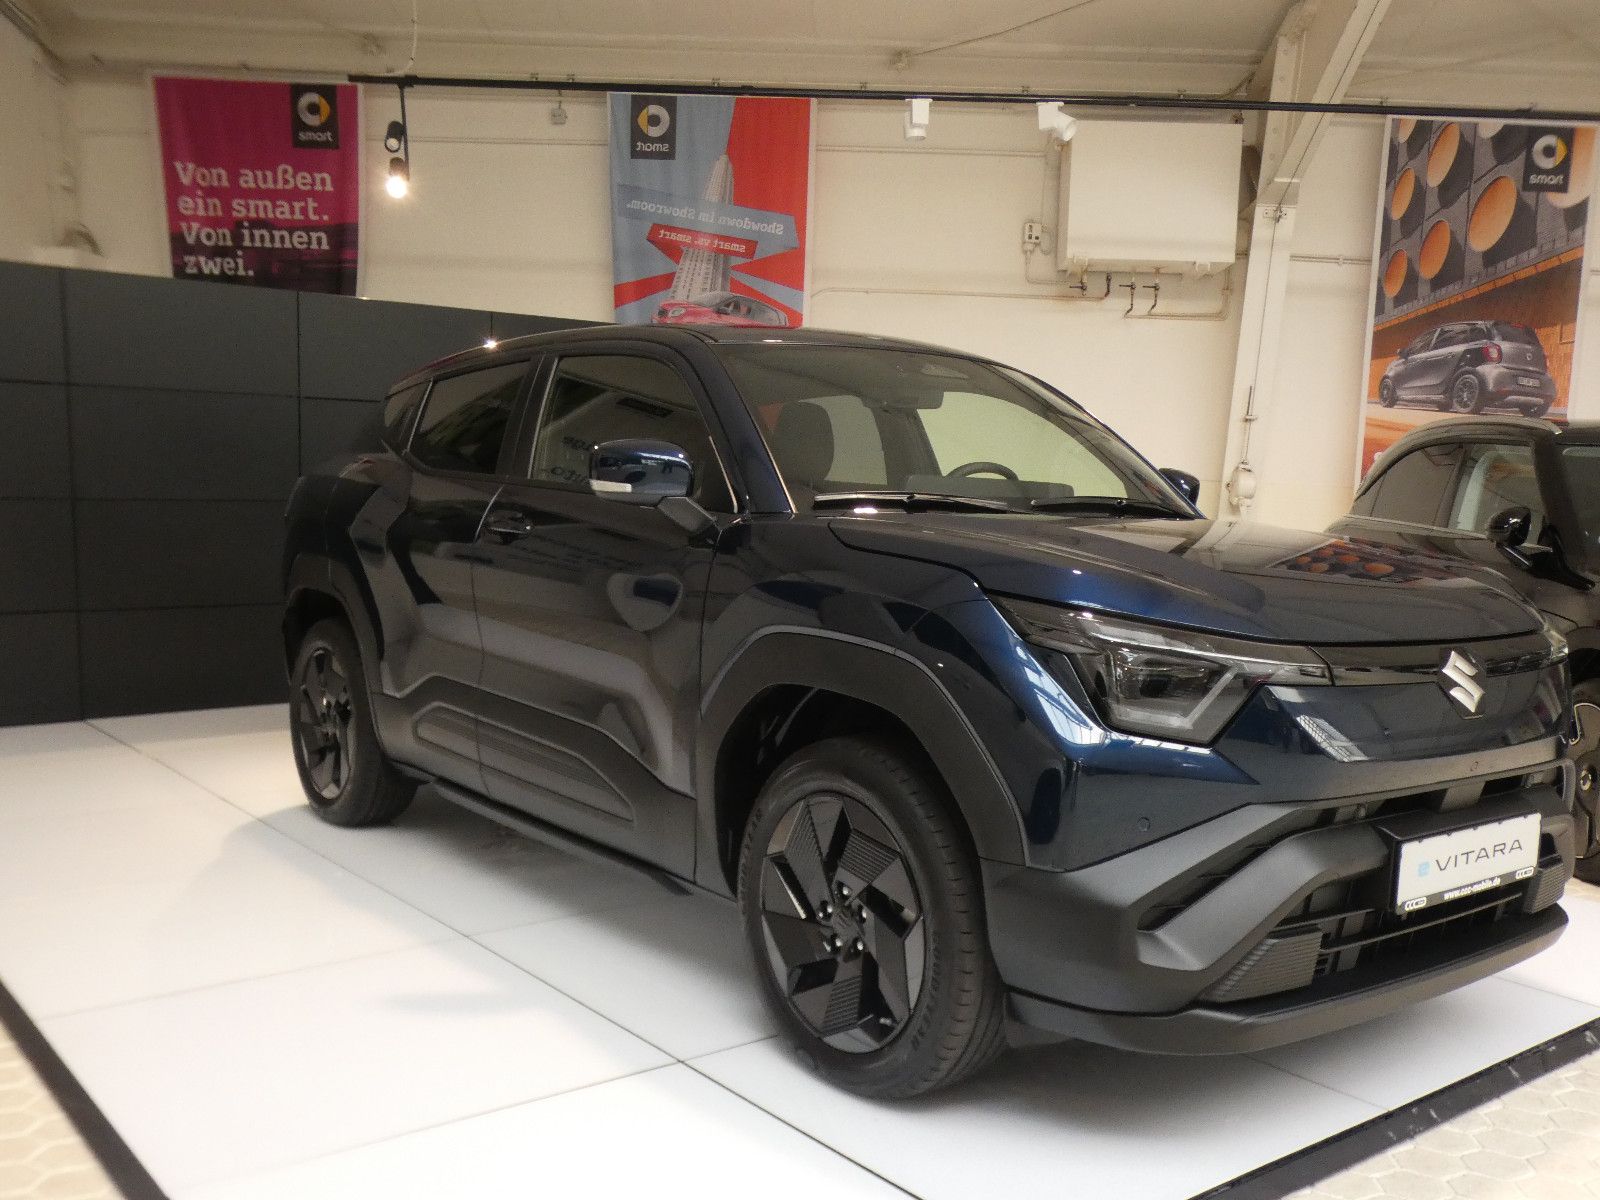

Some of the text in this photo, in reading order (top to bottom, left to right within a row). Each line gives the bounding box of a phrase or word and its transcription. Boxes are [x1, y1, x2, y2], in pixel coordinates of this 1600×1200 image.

[298, 131, 333, 141] smart
[173, 160, 334, 192] Von außen
[1529, 174, 1564, 184] smart
[176, 191, 329, 221] ein smart.
[180, 221, 330, 250] Von innen
[183, 250, 254, 277] zwei.
[1435, 839, 1523, 871] VITARA
